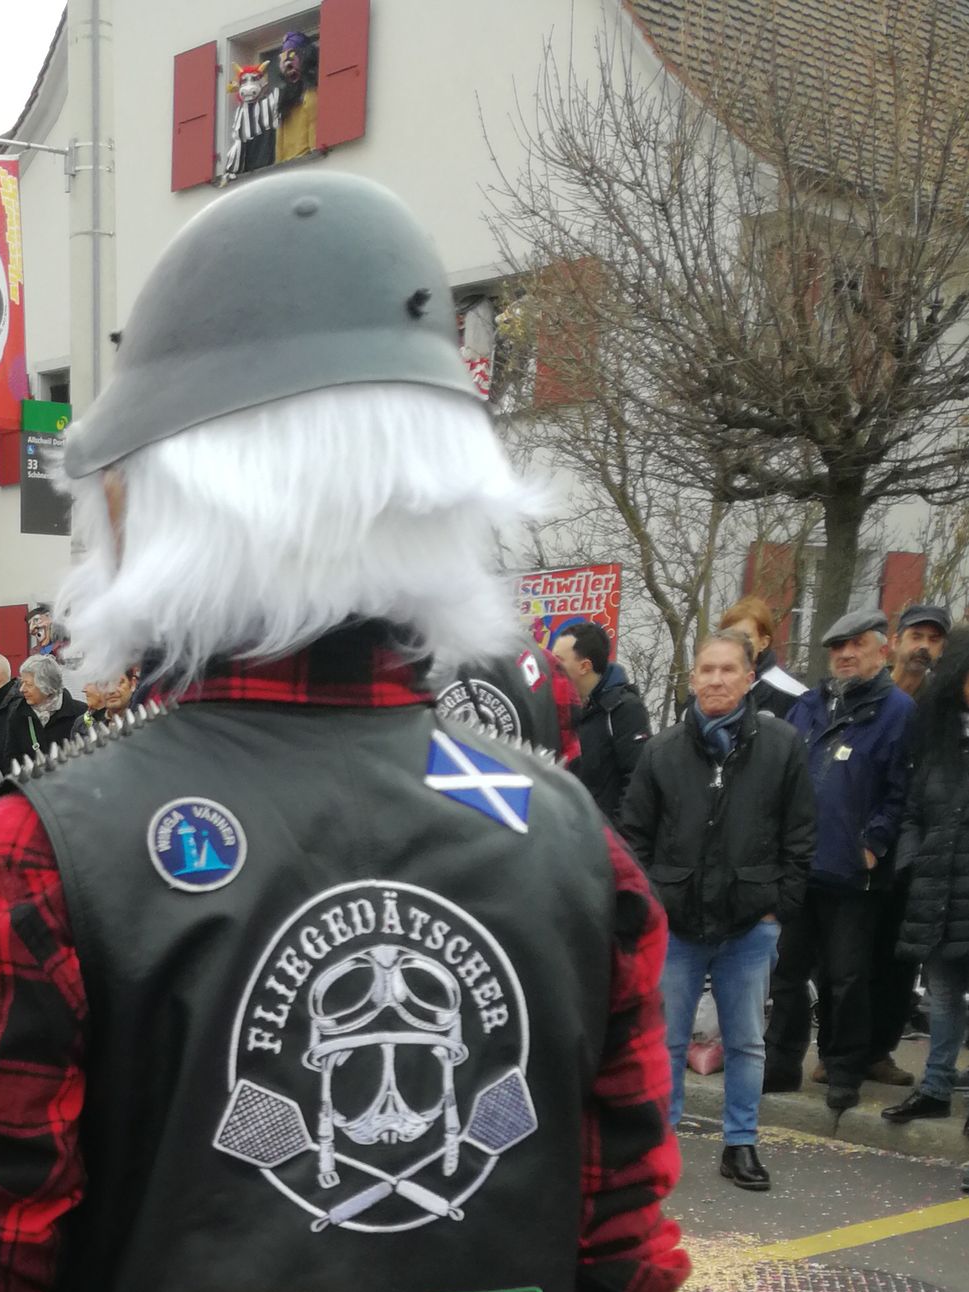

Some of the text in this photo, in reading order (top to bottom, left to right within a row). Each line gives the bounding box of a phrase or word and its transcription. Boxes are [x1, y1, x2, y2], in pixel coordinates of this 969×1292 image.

[27, 459, 38, 470] 33
[519, 593, 606, 615] asnacht
[247, 890, 510, 1055] FLIEGEDÄTSCHER
